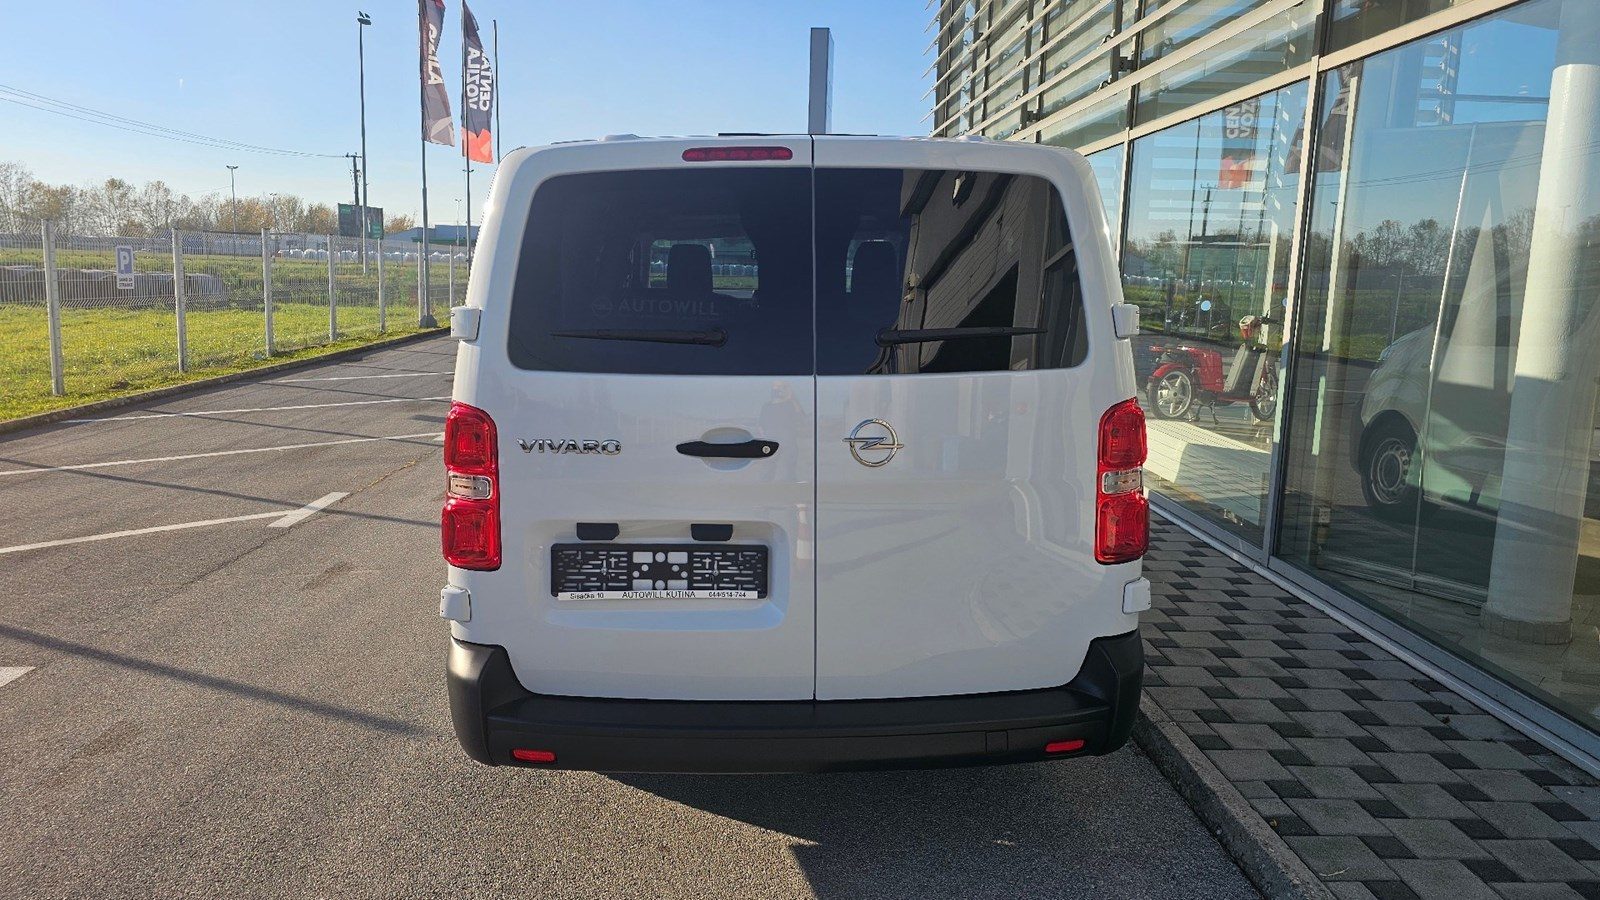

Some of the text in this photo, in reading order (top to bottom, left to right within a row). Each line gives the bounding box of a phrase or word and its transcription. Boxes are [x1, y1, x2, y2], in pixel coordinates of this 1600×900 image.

[120, 251, 130, 271] P
[618, 298, 719, 316] AUTOWILL
[516, 438, 622, 456] VIVARO
[622, 591, 665, 599] AUTOWILL
